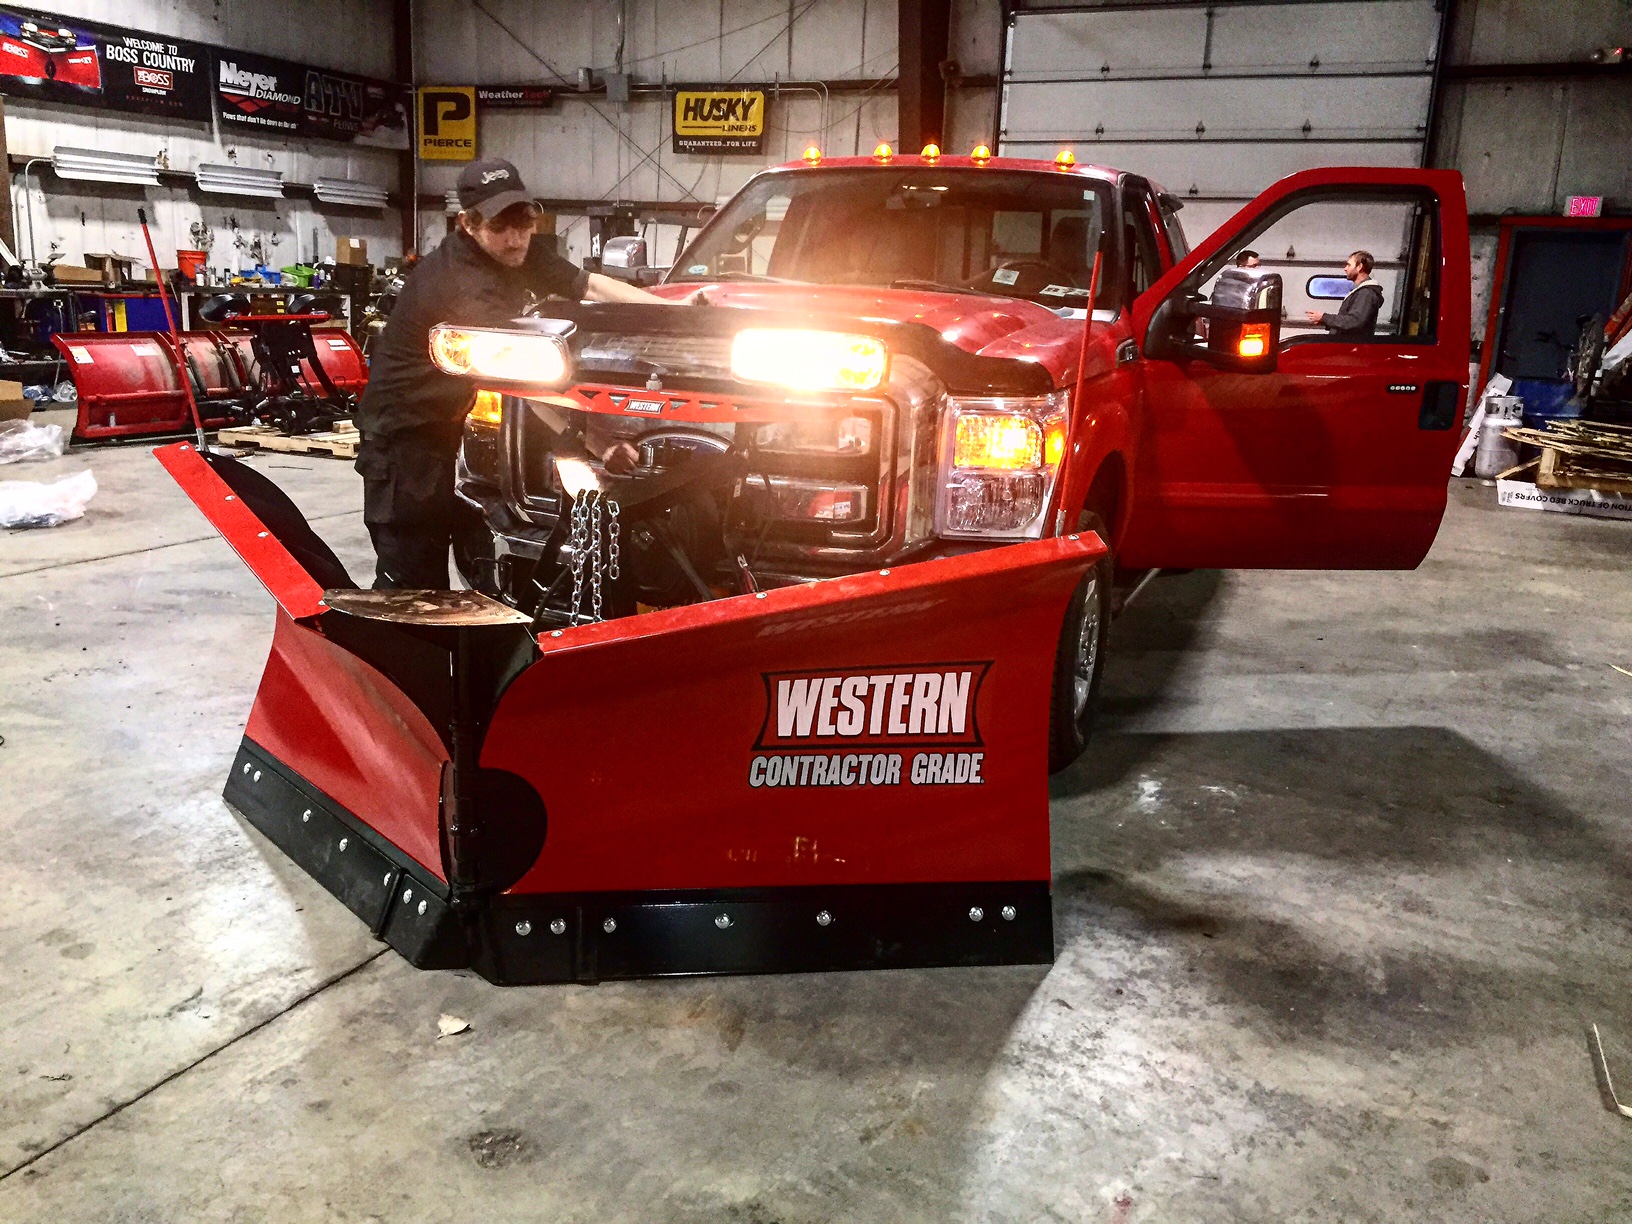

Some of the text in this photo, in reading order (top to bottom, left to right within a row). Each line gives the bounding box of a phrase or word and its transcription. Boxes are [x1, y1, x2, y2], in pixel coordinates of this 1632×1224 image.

[123, 37, 177, 55] WELCOME TO
[106, 44, 195, 73] BOSS COUNTRY
[220, 60, 277, 97] Meyer
[256, 90, 301, 104] DIAMOND
[683, 97, 758, 122] HUSKY
[722, 124, 757, 132] LINERS
[424, 139, 472, 148] PIERCE
[481, 170, 509, 184] Jeep
[1570, 198, 1598, 215] EXIT
[629, 401, 661, 412] WESTERN
[1515, 492, 1548, 502] COVERS
[1550, 496, 1567, 505] BED
[1568, 498, 1597, 508] TRUCK
[777, 671, 972, 737] WESTERN
[750, 754, 902, 787] CONTRACTOR
